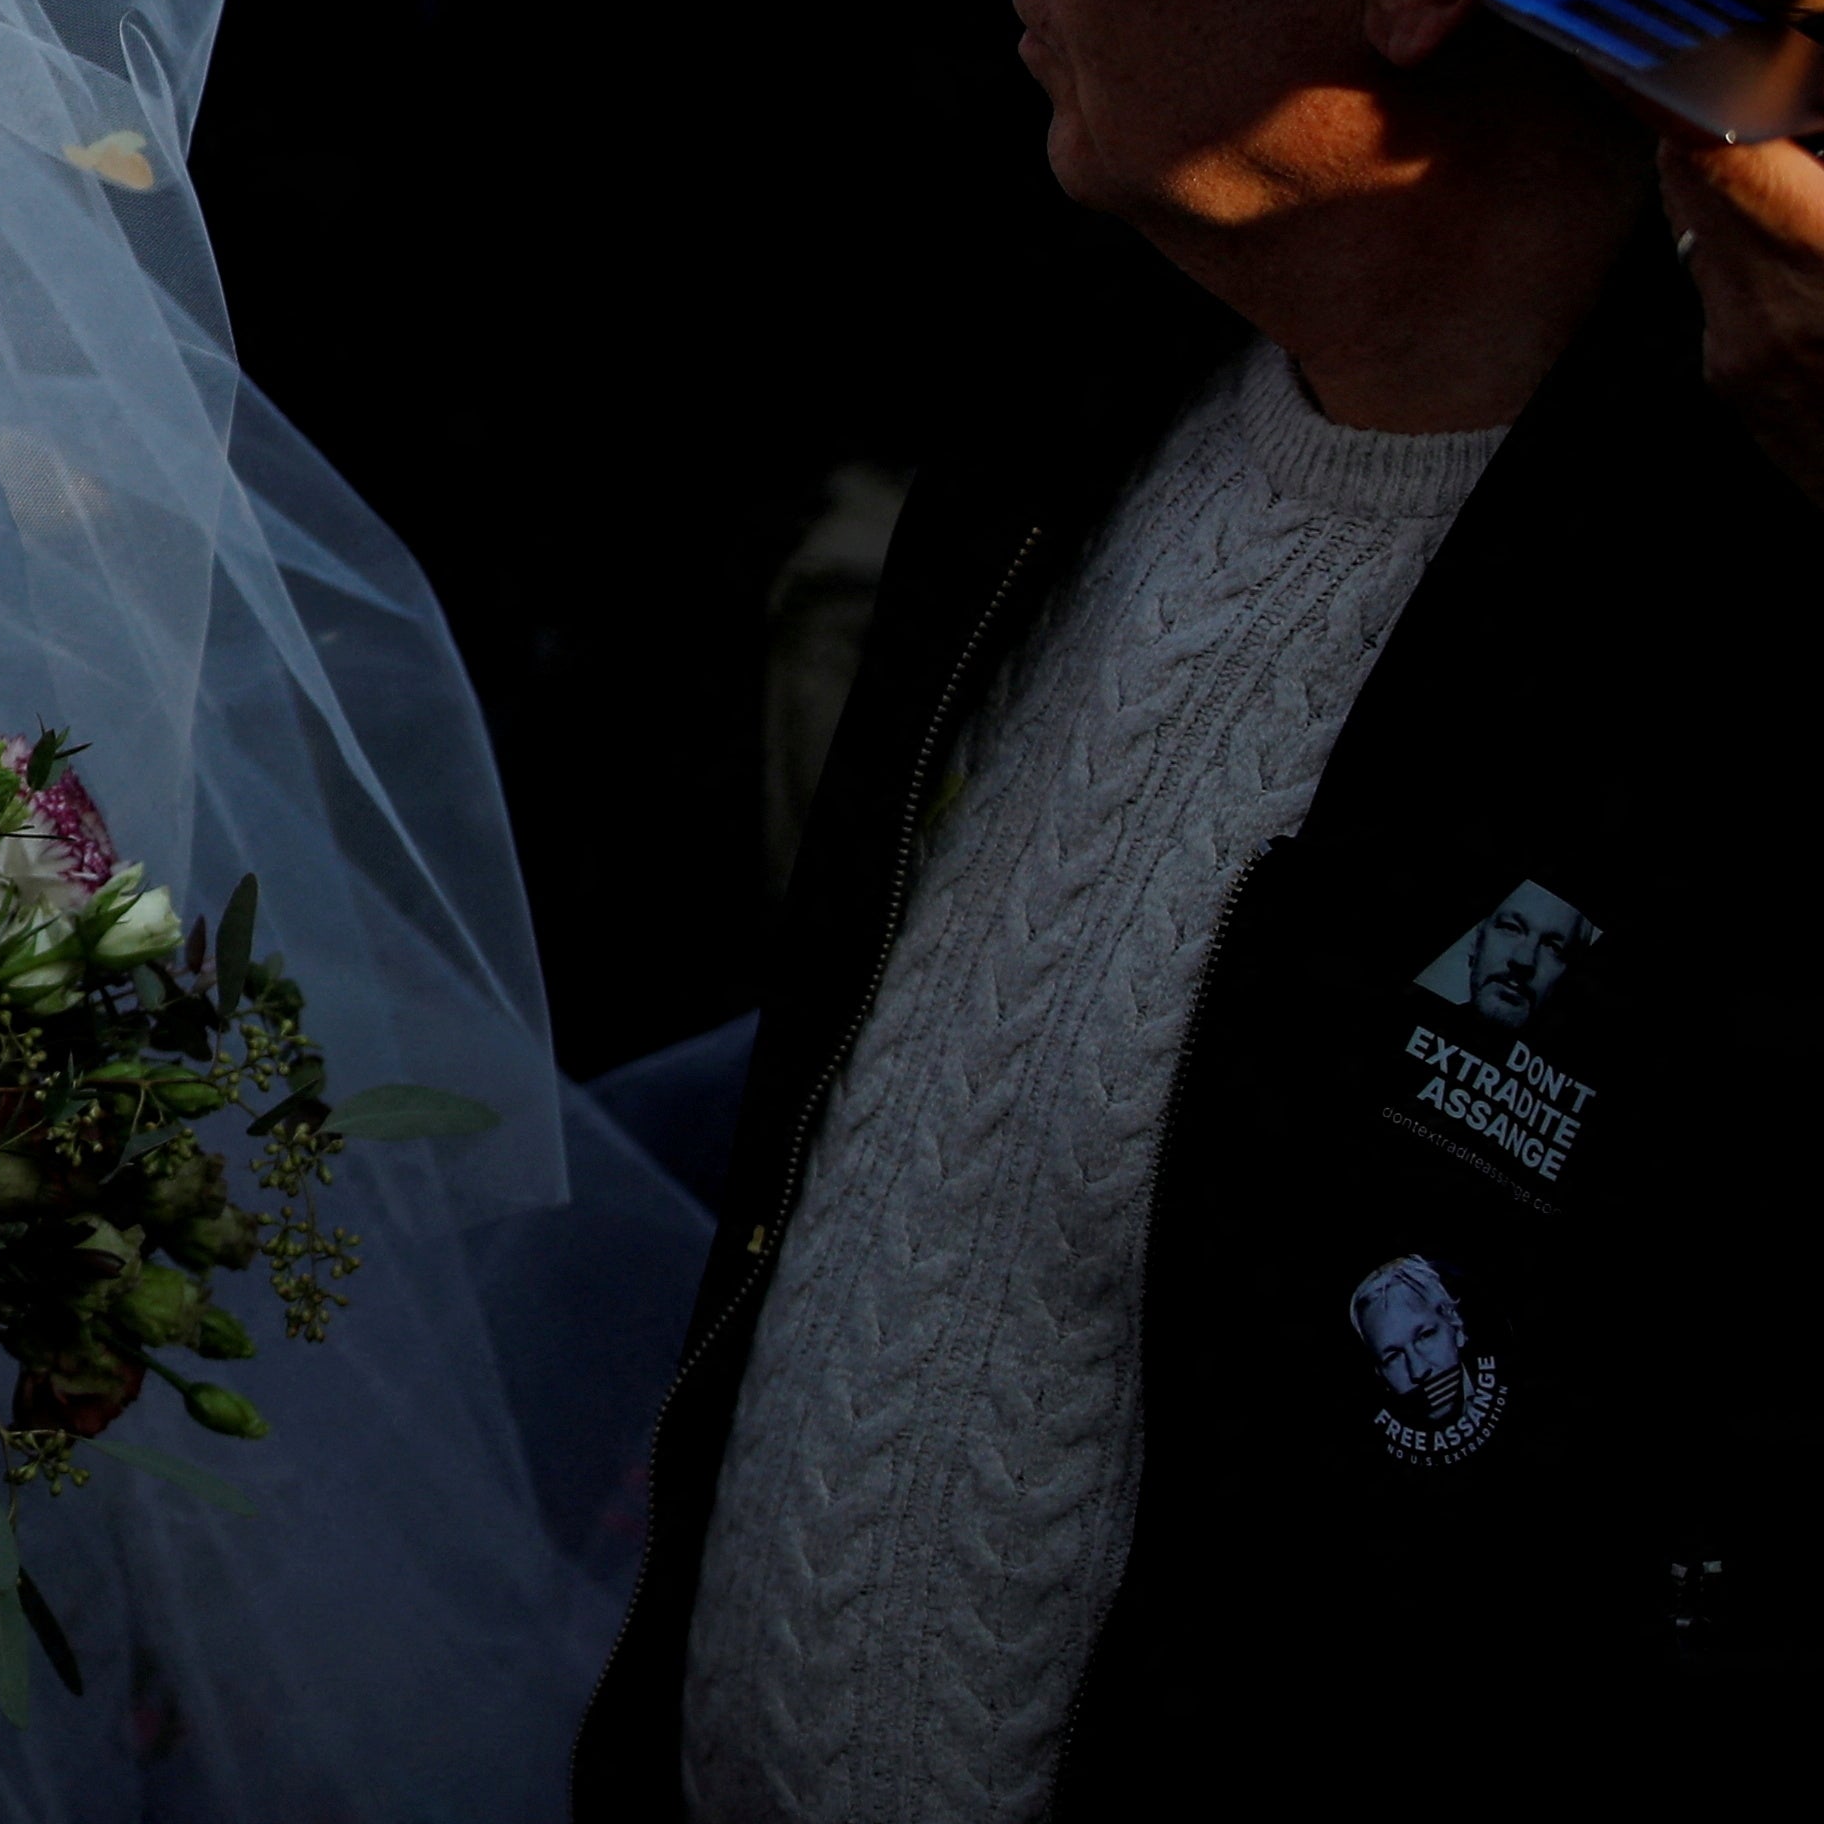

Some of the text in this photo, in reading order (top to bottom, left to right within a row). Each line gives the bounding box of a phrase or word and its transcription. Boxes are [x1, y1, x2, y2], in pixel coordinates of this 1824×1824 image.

[1404, 1024, 1582, 1152] EXTRADITE
[1505, 1039, 1599, 1115] DON'T
[1415, 1075, 1568, 1183] ASSANGE
[1373, 1355, 1497, 1452] FREE ASSANGE
[1385, 1443, 1404, 1460] NO
[1443, 1384, 1510, 1465] EXTRADITION
